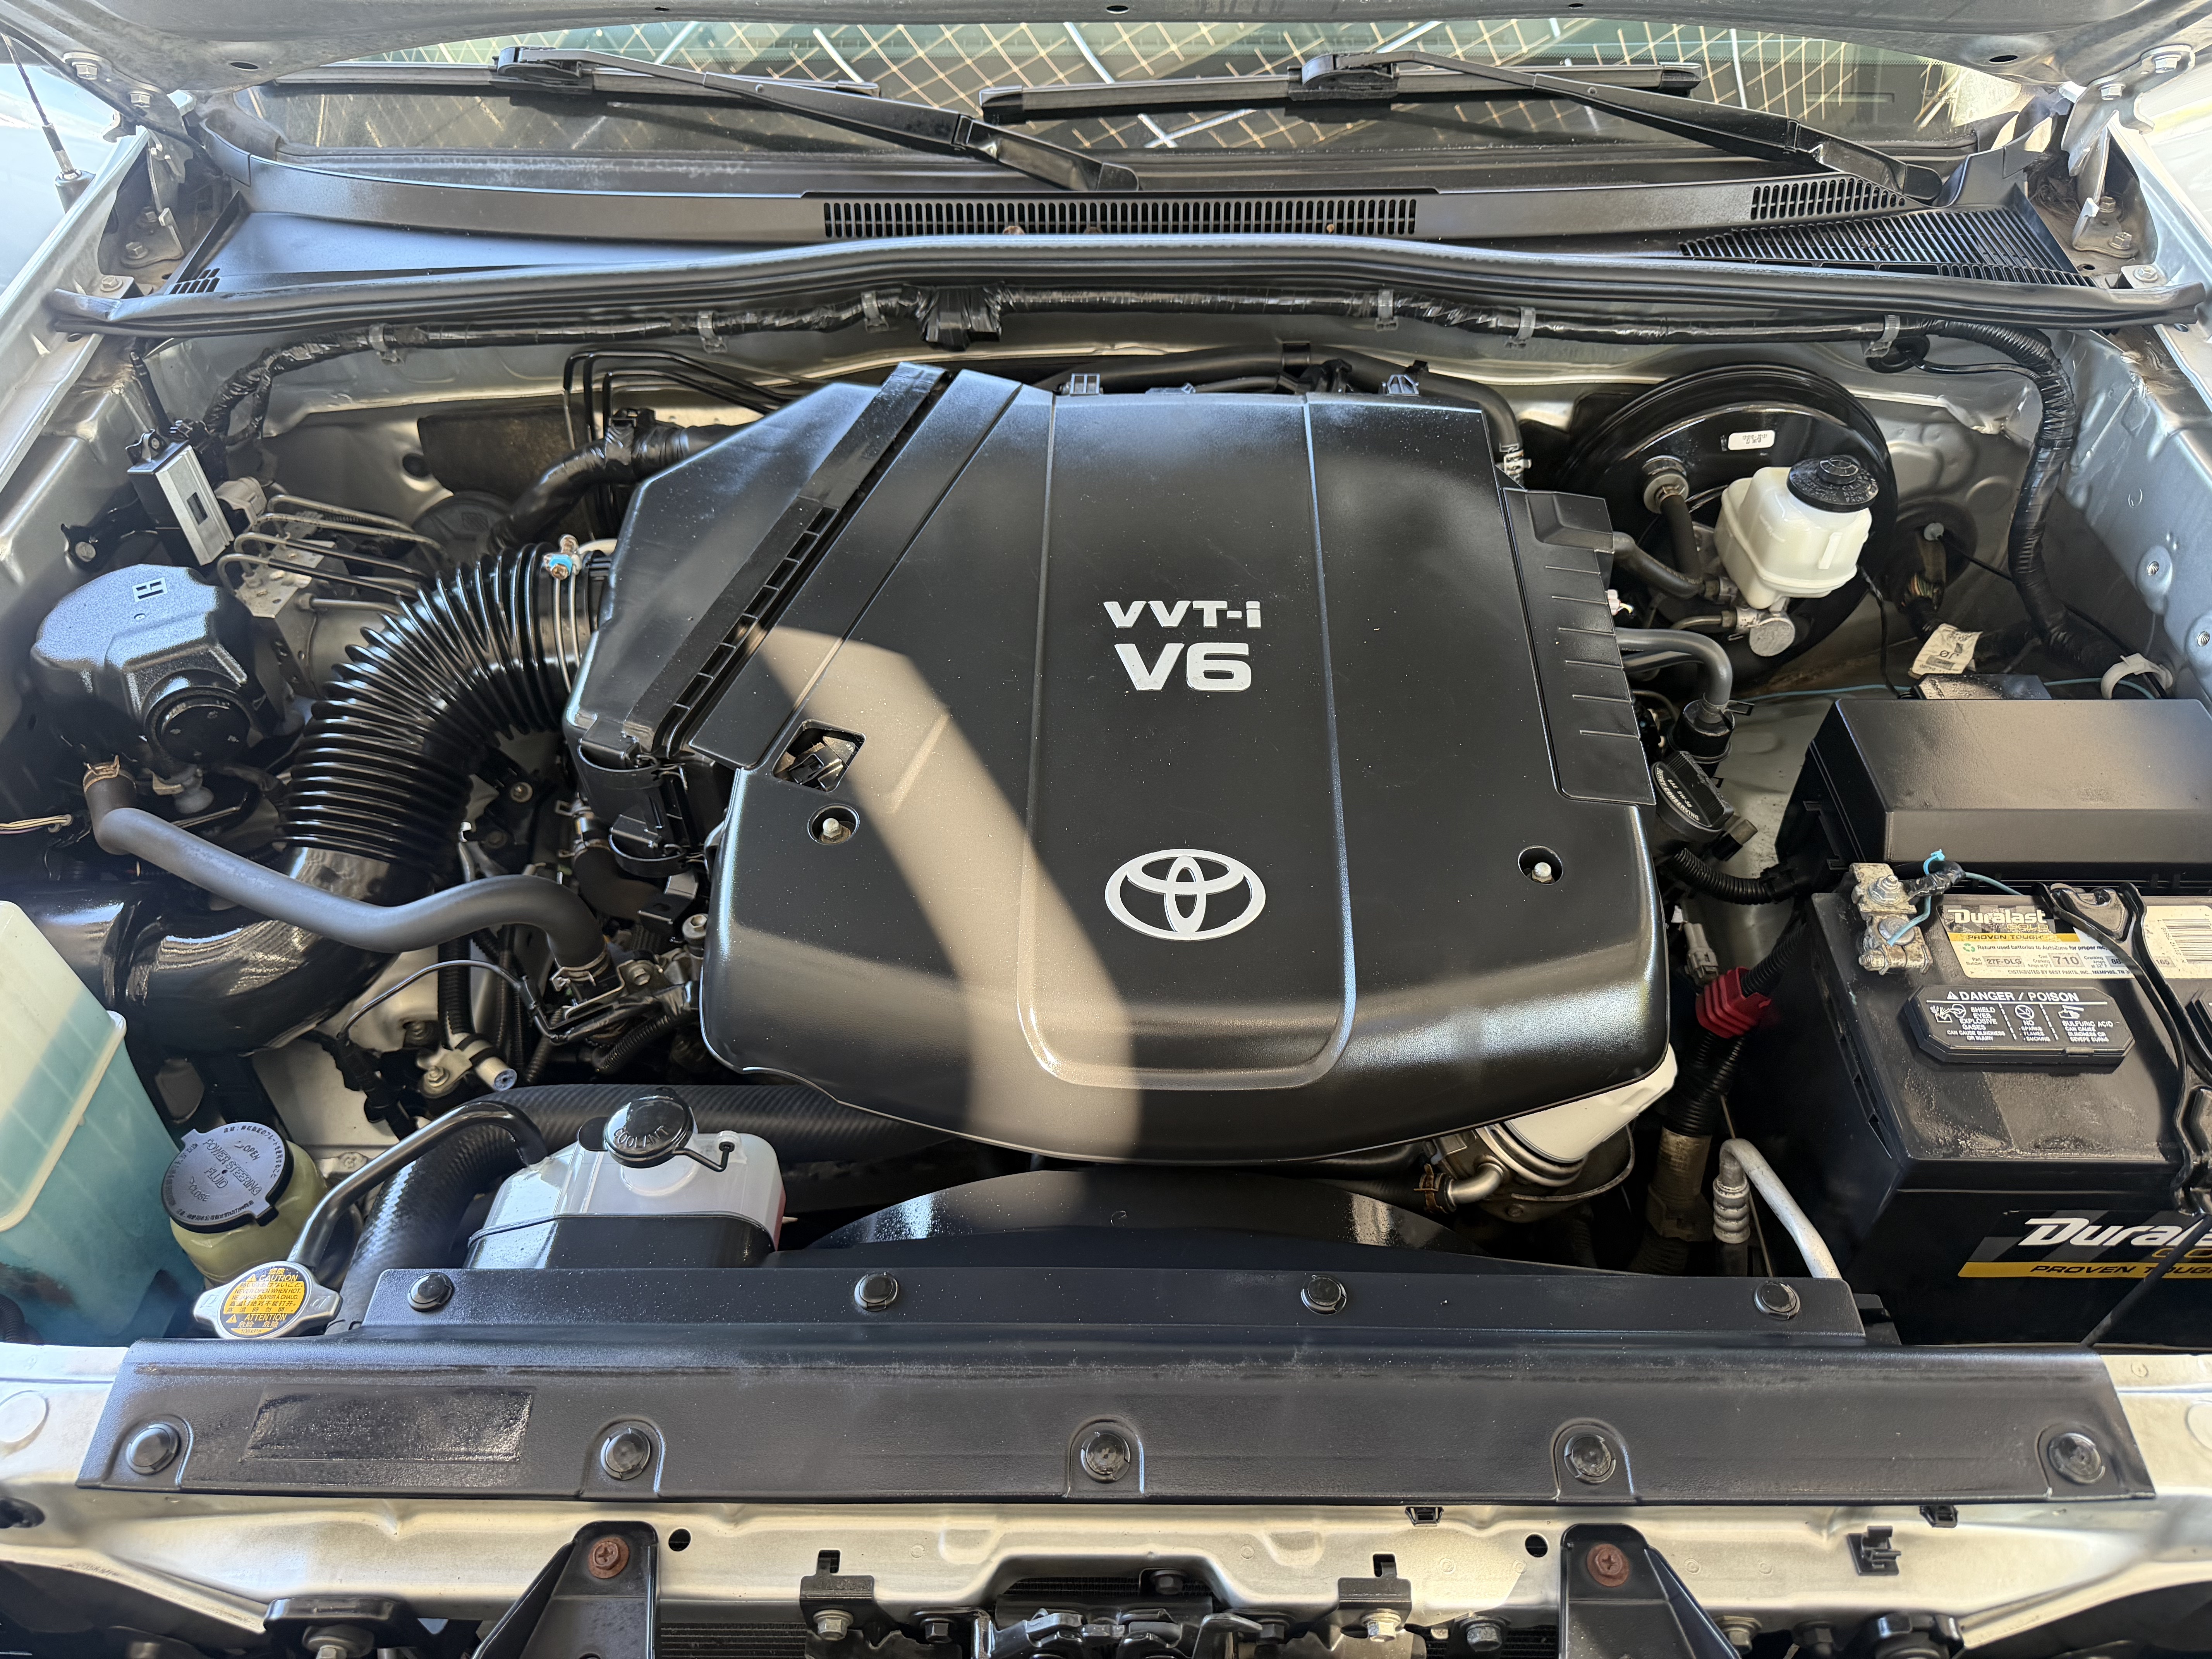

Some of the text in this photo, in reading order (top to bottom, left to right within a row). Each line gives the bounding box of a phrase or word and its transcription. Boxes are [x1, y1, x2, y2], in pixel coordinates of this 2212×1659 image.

[1103, 600, 1262, 629] VVT-i
[1114, 642, 1252, 692] V6
[1667, 779, 1679, 789] SAE
[1664, 787, 1700, 821] CONSERVING
[1947, 909, 2047, 924] Duralast
[2053, 956, 2080, 965] 710
[1959, 991, 2015, 1001] DANGER
[2028, 992, 2080, 1002] POISON
[613, 1125, 670, 1148] COOLANT
[244, 1145, 261, 1161] OPEN
[203, 1137, 232, 1164] POWER
[225, 1161, 262, 1196] STEERING
[204, 1166, 228, 1188] FLUID
[189, 1183, 210, 1202] CLOSE
[244, 1313, 288, 1321] ATTENTION
